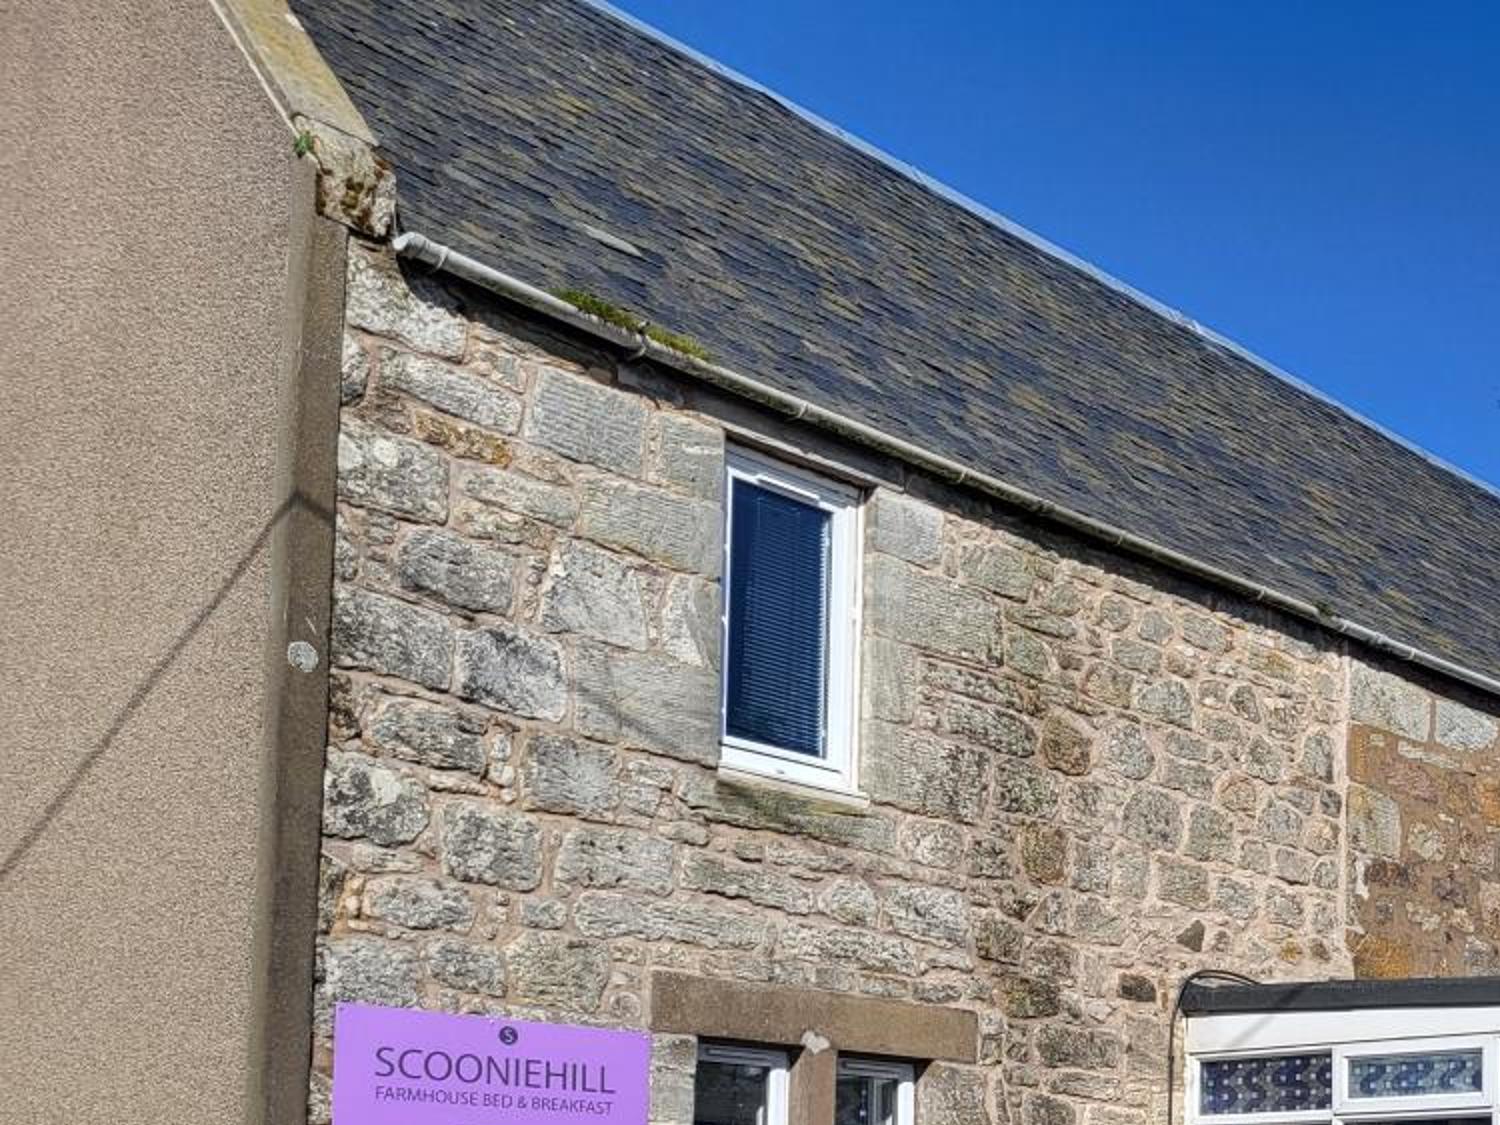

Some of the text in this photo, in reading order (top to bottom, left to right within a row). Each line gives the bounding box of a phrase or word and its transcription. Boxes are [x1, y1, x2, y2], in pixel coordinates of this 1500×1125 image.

[375, 1047, 616, 1094] SCOONIEHILL
[375, 1085, 613, 1115] FARMHOUSE BED & BREAKFAST
